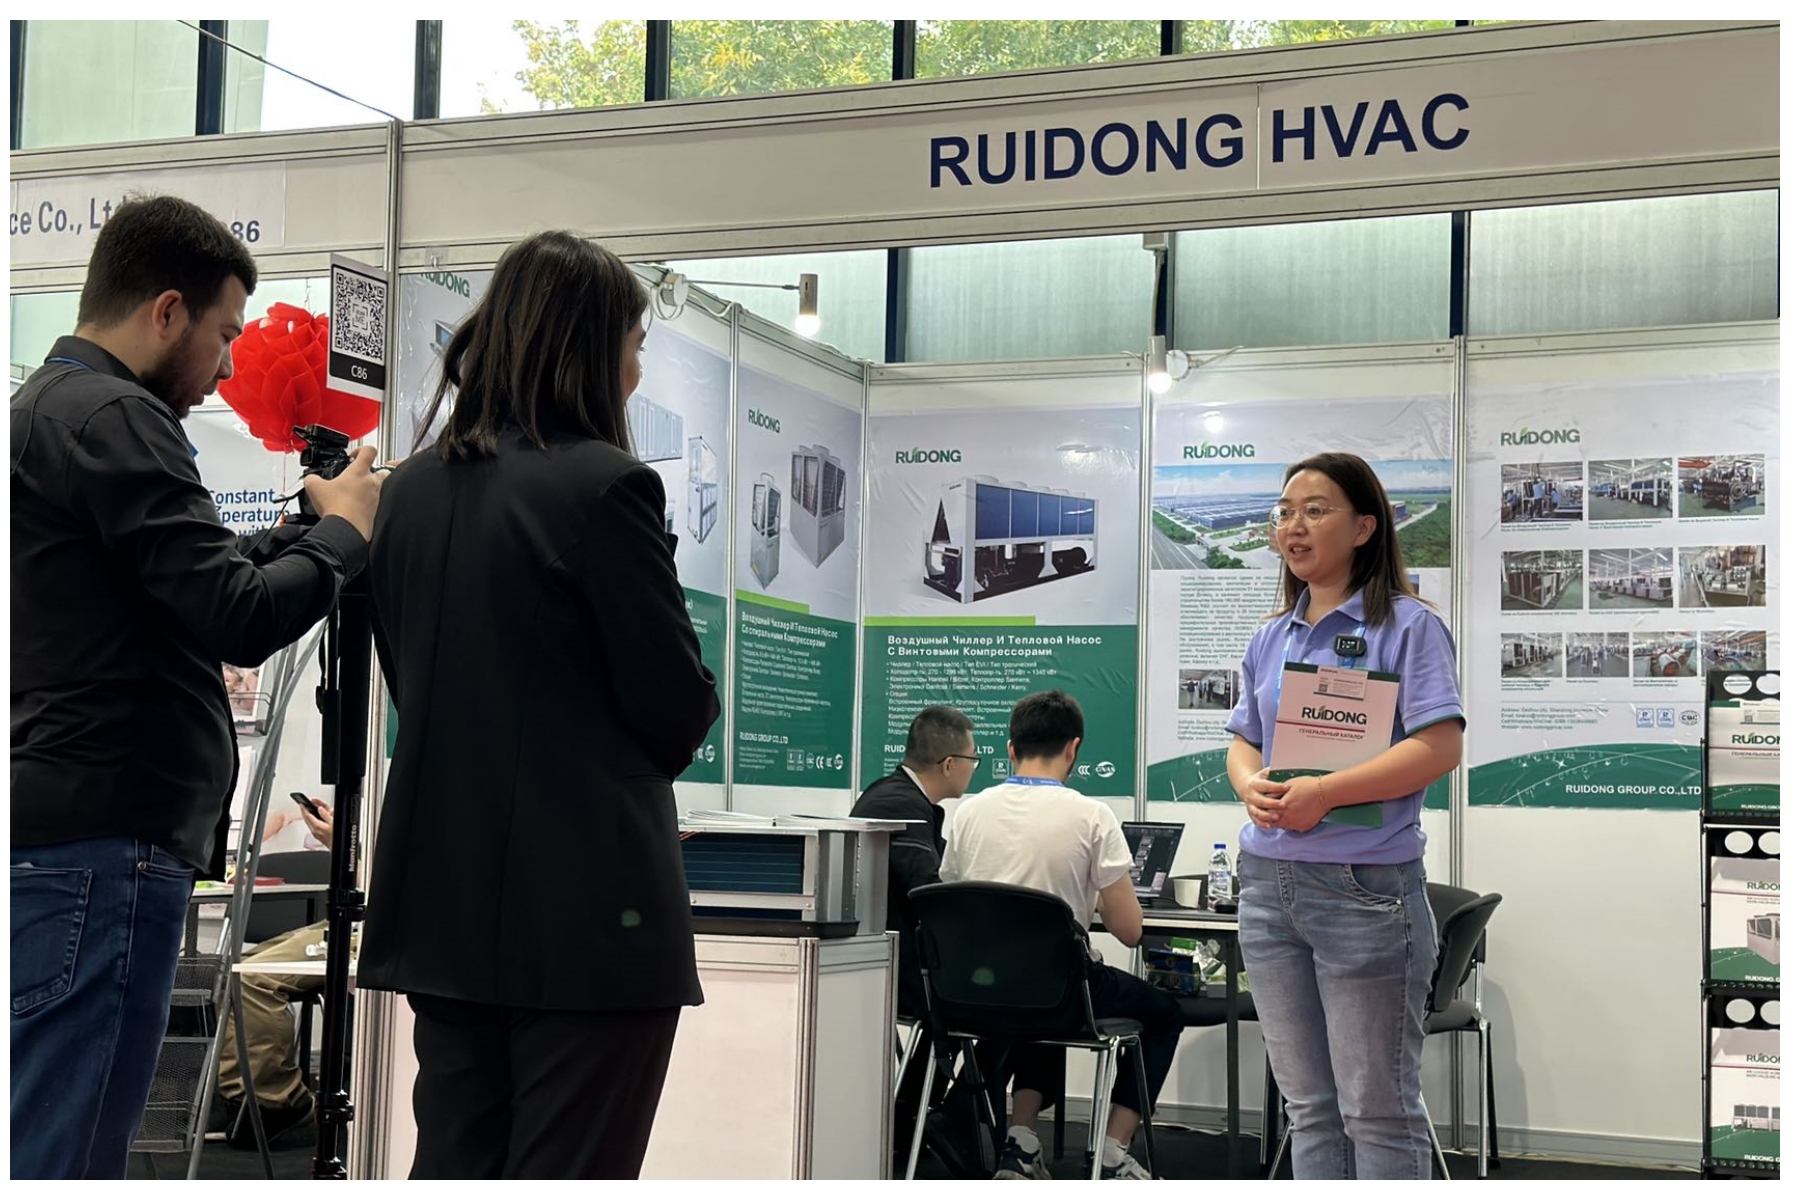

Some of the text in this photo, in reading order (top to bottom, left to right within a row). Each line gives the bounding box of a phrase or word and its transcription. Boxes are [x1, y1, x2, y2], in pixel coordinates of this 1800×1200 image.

[929, 93, 1471, 188] RUIDONG HVAC
[38, 201, 83, 236] Co.,
[90, 196, 127, 230] Lt
[351, 365, 368, 380] C86
[748, 408, 781, 434] RUIDONG
[1500, 427, 1580, 446] RUIDONG
[895, 447, 962, 464] RUIDONG
[1183, 442, 1255, 459] RUIDONG
[887, 635, 1102, 647] Воздушный Чиллер И Тепловой Насос
[898, 647, 959, 656] Винтовыми
[963, 647, 1052, 658] Компрессорами
[1301, 706, 1368, 726] RUIDONG
[1732, 732, 1780, 745] RUIDO
[1565, 784, 1701, 796] RUIDONG GROUP CO.,LTD
[348, 824, 358, 872] Manfrotto
[1746, 1053, 1780, 1064] RUIDO
